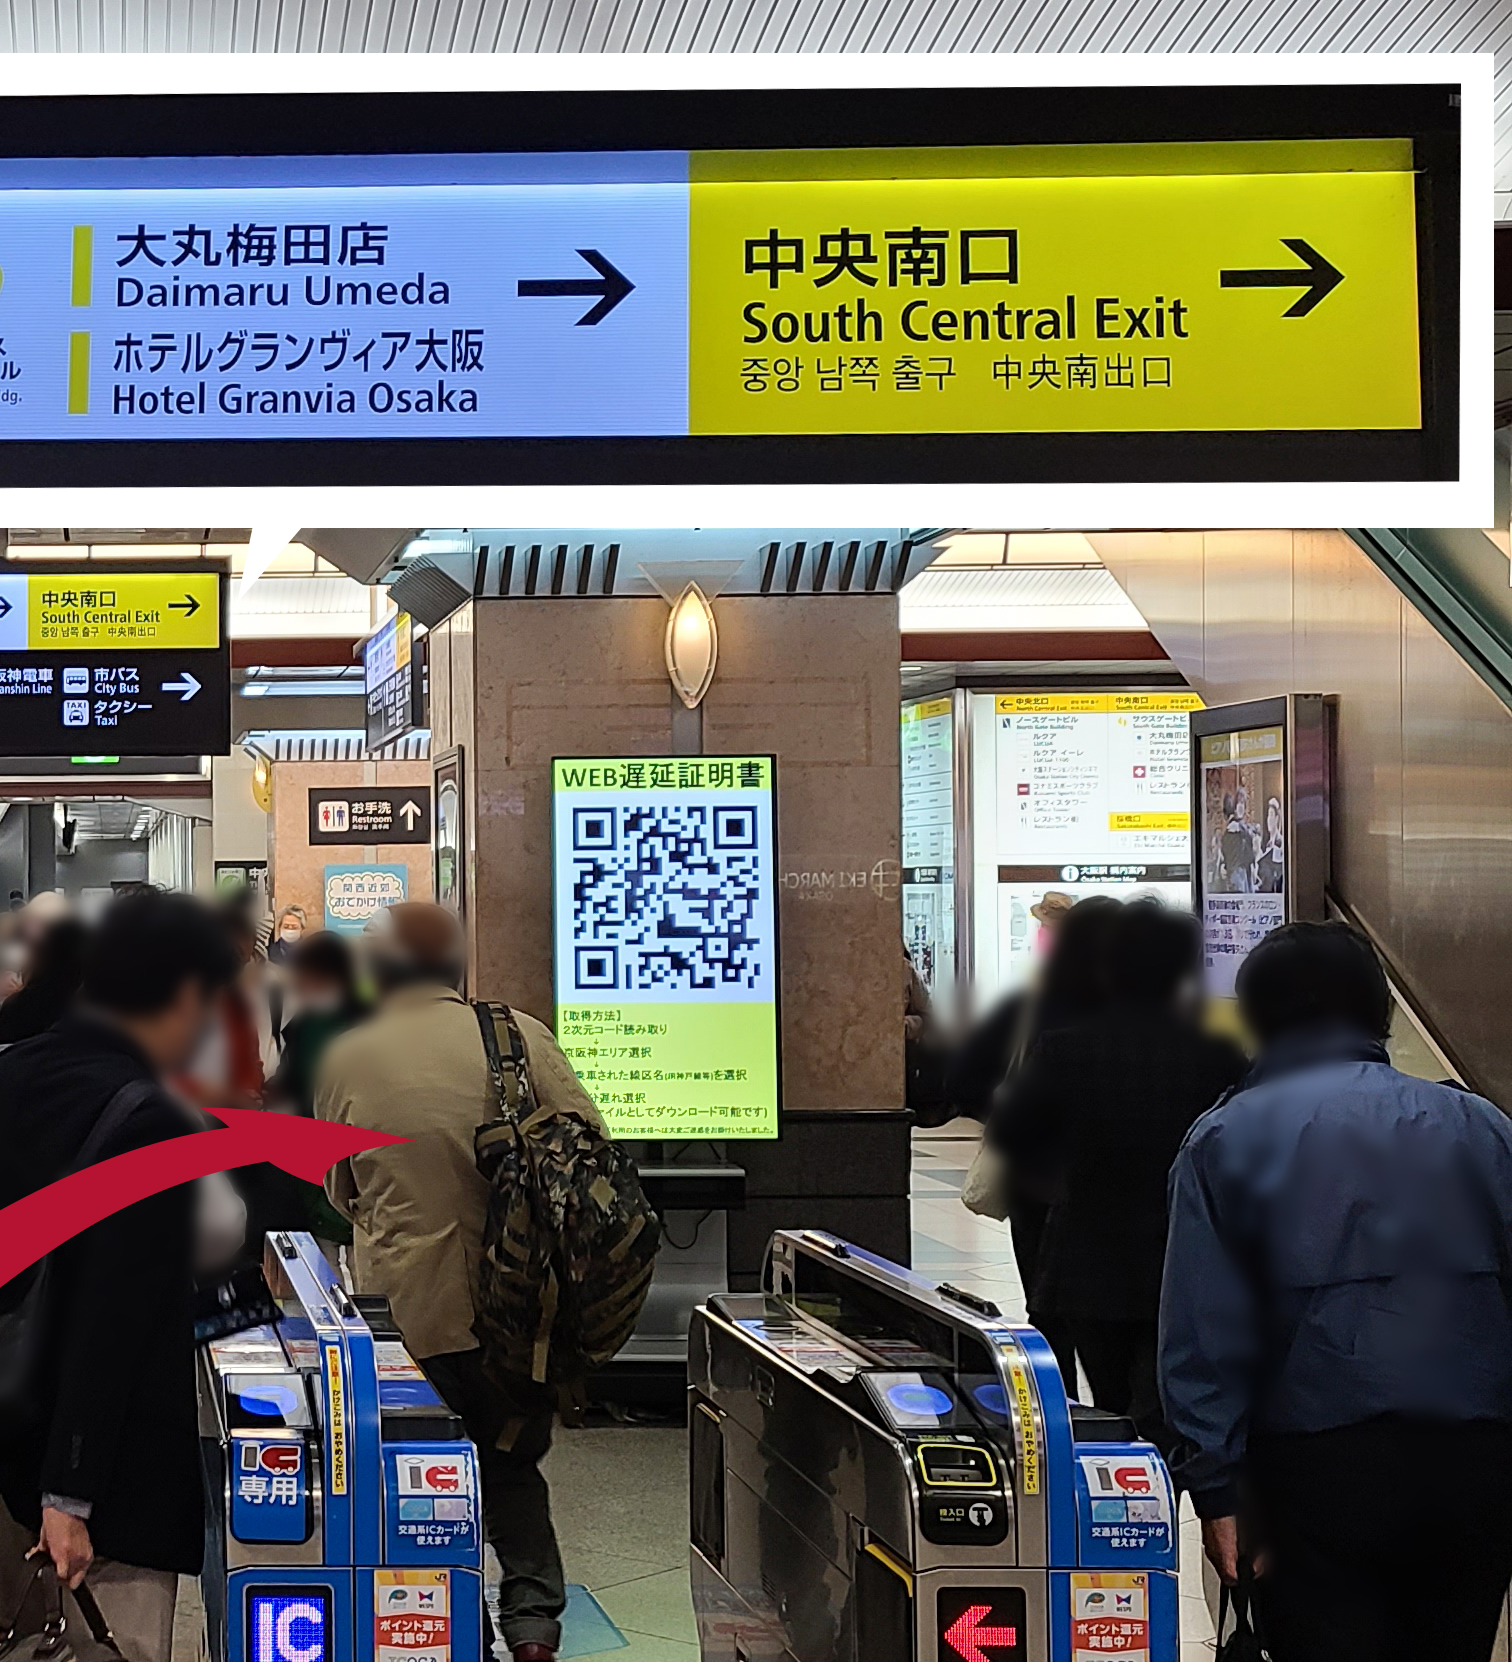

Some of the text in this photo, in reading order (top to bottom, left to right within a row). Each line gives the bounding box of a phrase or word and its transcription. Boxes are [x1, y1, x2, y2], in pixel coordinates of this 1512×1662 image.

[42, 590, 116, 608] 中央南口
[41, 609, 161, 624] South Central Exit
[94, 667, 139, 681] 市バス
[32, 683, 53, 695] Line
[94, 683, 139, 696] City Bus
[93, 700, 153, 713] タクシー
[94, 714, 118, 726] Taxi
[562, 760, 765, 789] WEB遅延証明書
[351, 801, 392, 815] お手洗
[352, 815, 393, 824] Restroom
[239, 1475, 297, 1506] 専用
[398, 1524, 470, 1535] 交通系ICカードが
[1091, 1526, 1165, 1537] 交通系ICカードが
[417, 1535, 451, 1546] 使えます
[1110, 1538, 1147, 1548] 使えます
[258, 1601, 323, 1662] IC
